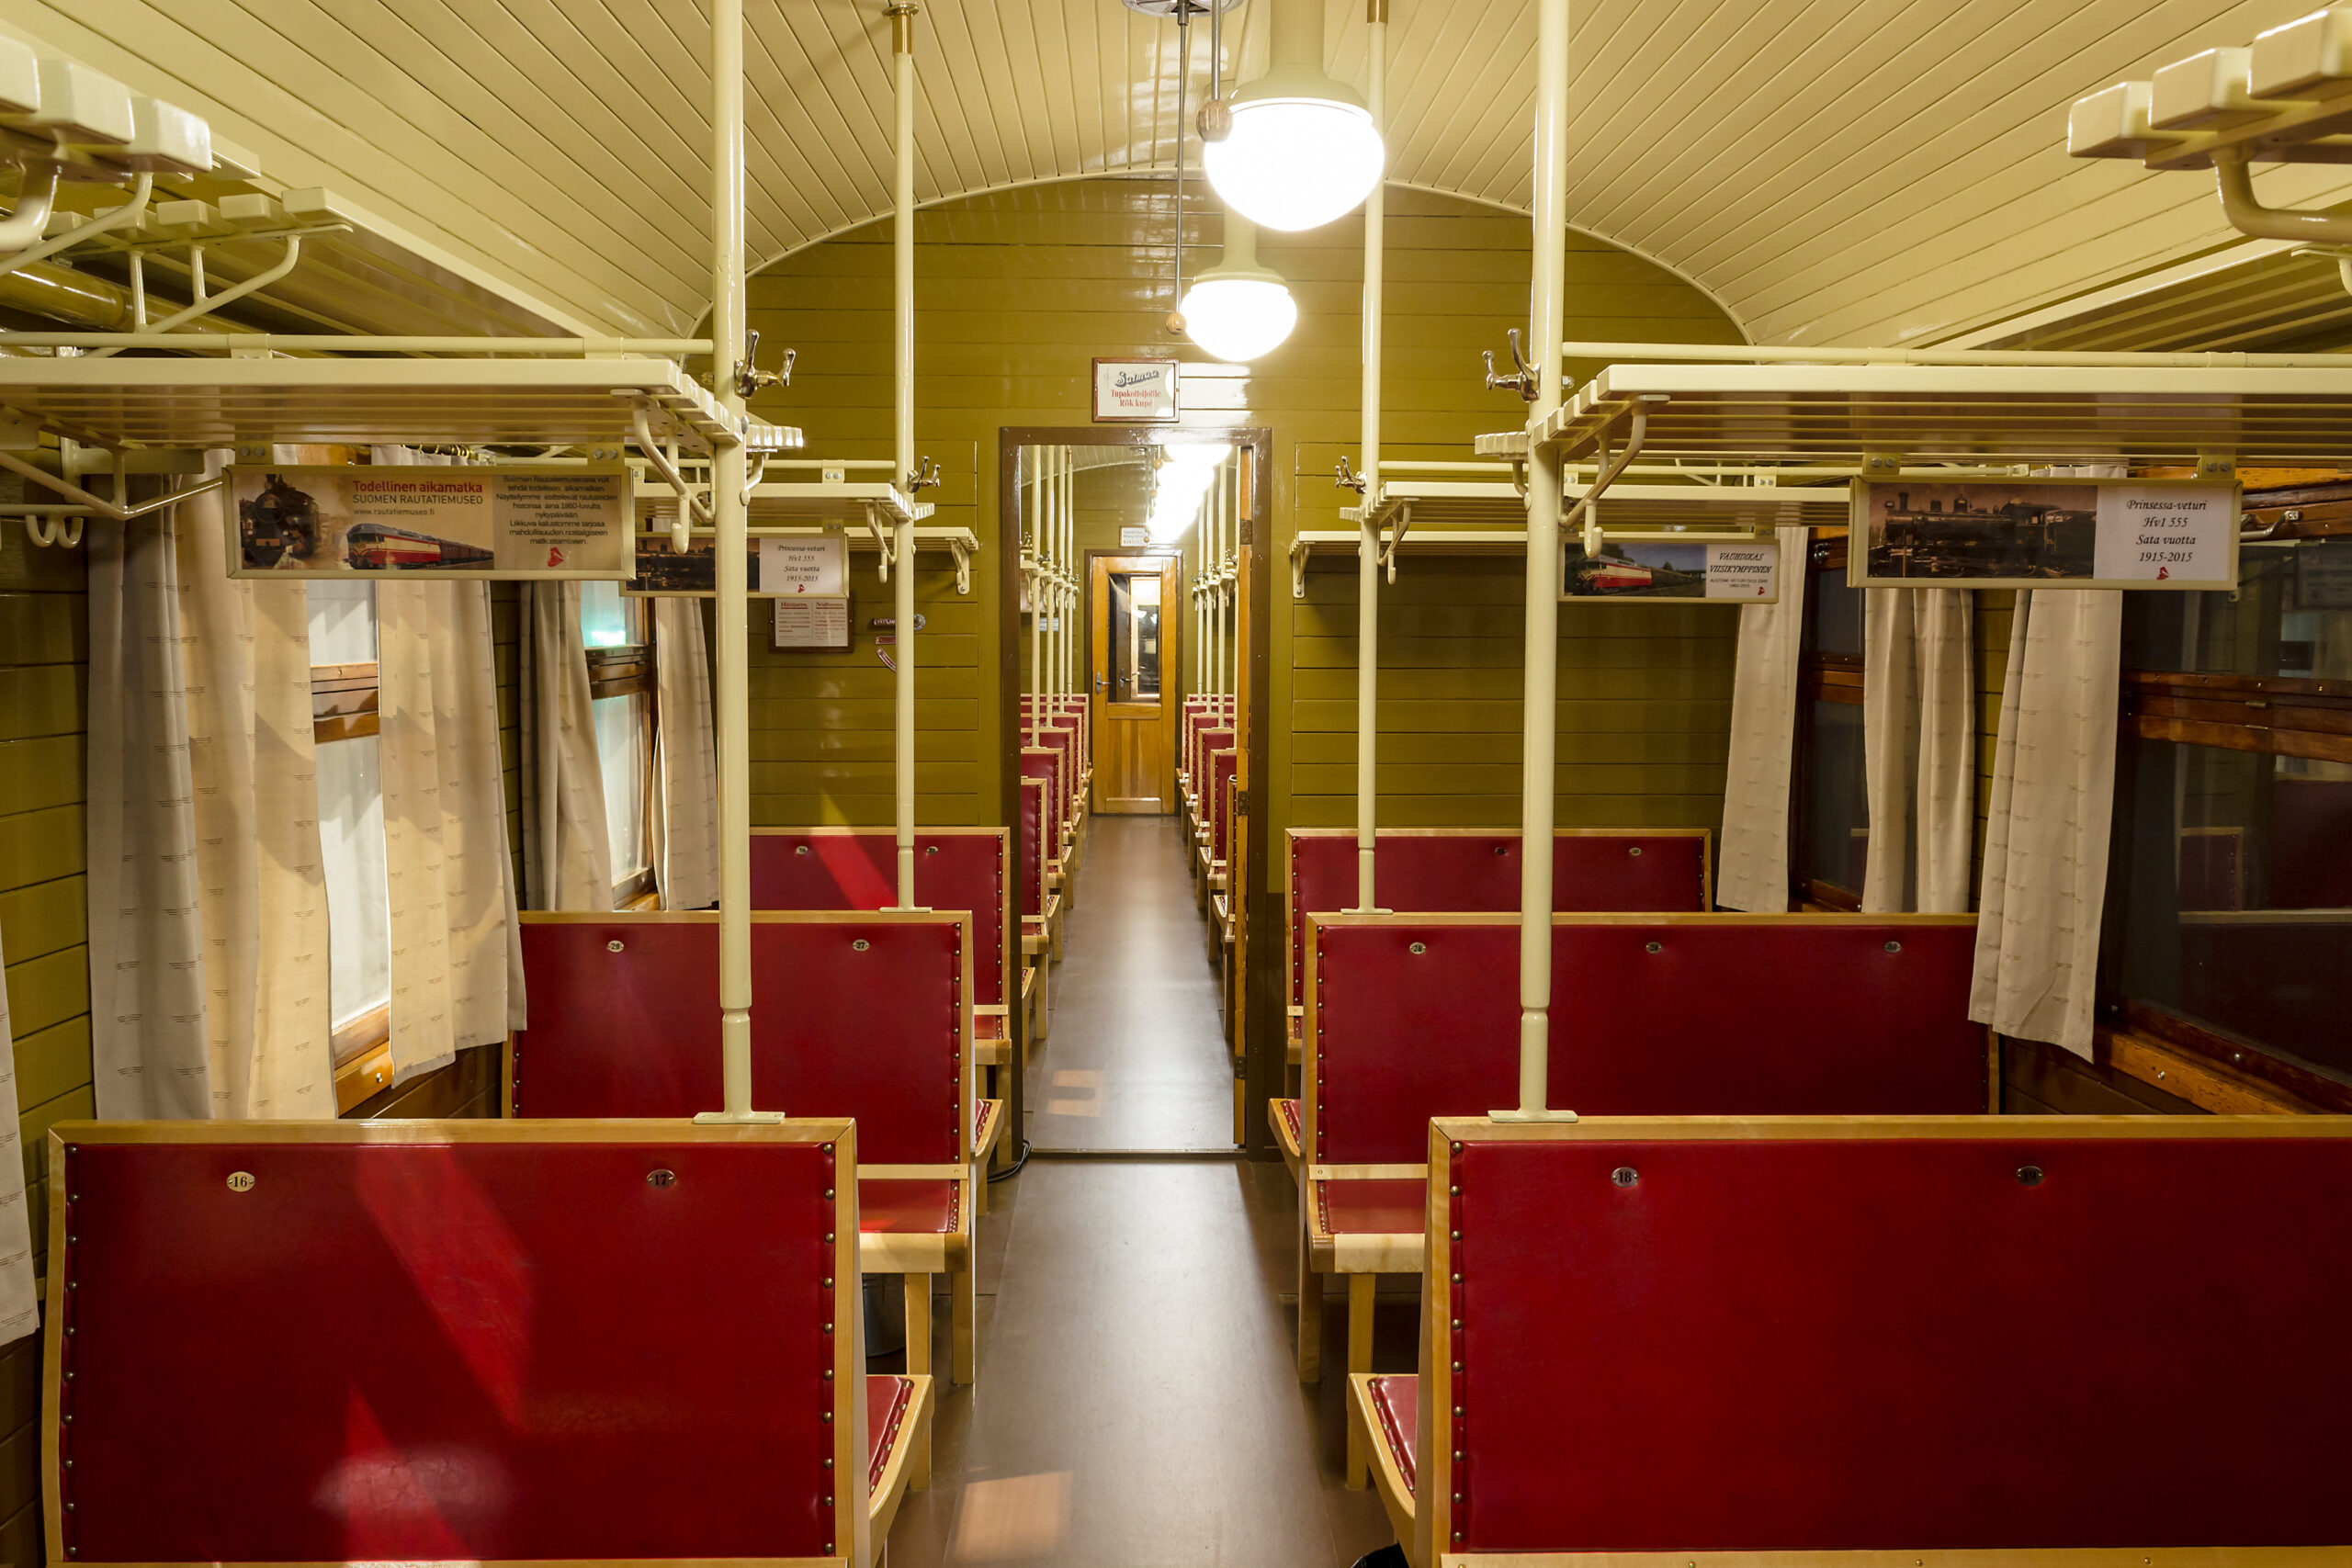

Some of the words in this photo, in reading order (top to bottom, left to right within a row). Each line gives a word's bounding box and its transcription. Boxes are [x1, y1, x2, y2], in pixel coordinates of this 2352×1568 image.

[353, 480, 416, 492] Todellinen
[419, 481, 482, 493] aikamatka
[353, 494, 397, 503] SUOMEN
[400, 495, 483, 504] RAUTATIEMUSEO
[2126, 500, 2208, 510] Prinsessa-veturi
[2143, 517, 2166, 527] Hv1
[2168, 517, 2188, 527] 555
[2136, 535, 2160, 546] Sata
[2163, 536, 2197, 545] vuotta
[1719, 552, 1765, 561] VAUHDIKAS
[2139, 552, 2193, 562] 1915-2015
[1710, 565, 1773, 574] VIISIKYMPPINEN
[233, 1176, 247, 1187] 16
[654, 1173, 668, 1185] 17
[1619, 1171, 1632, 1182] 18
